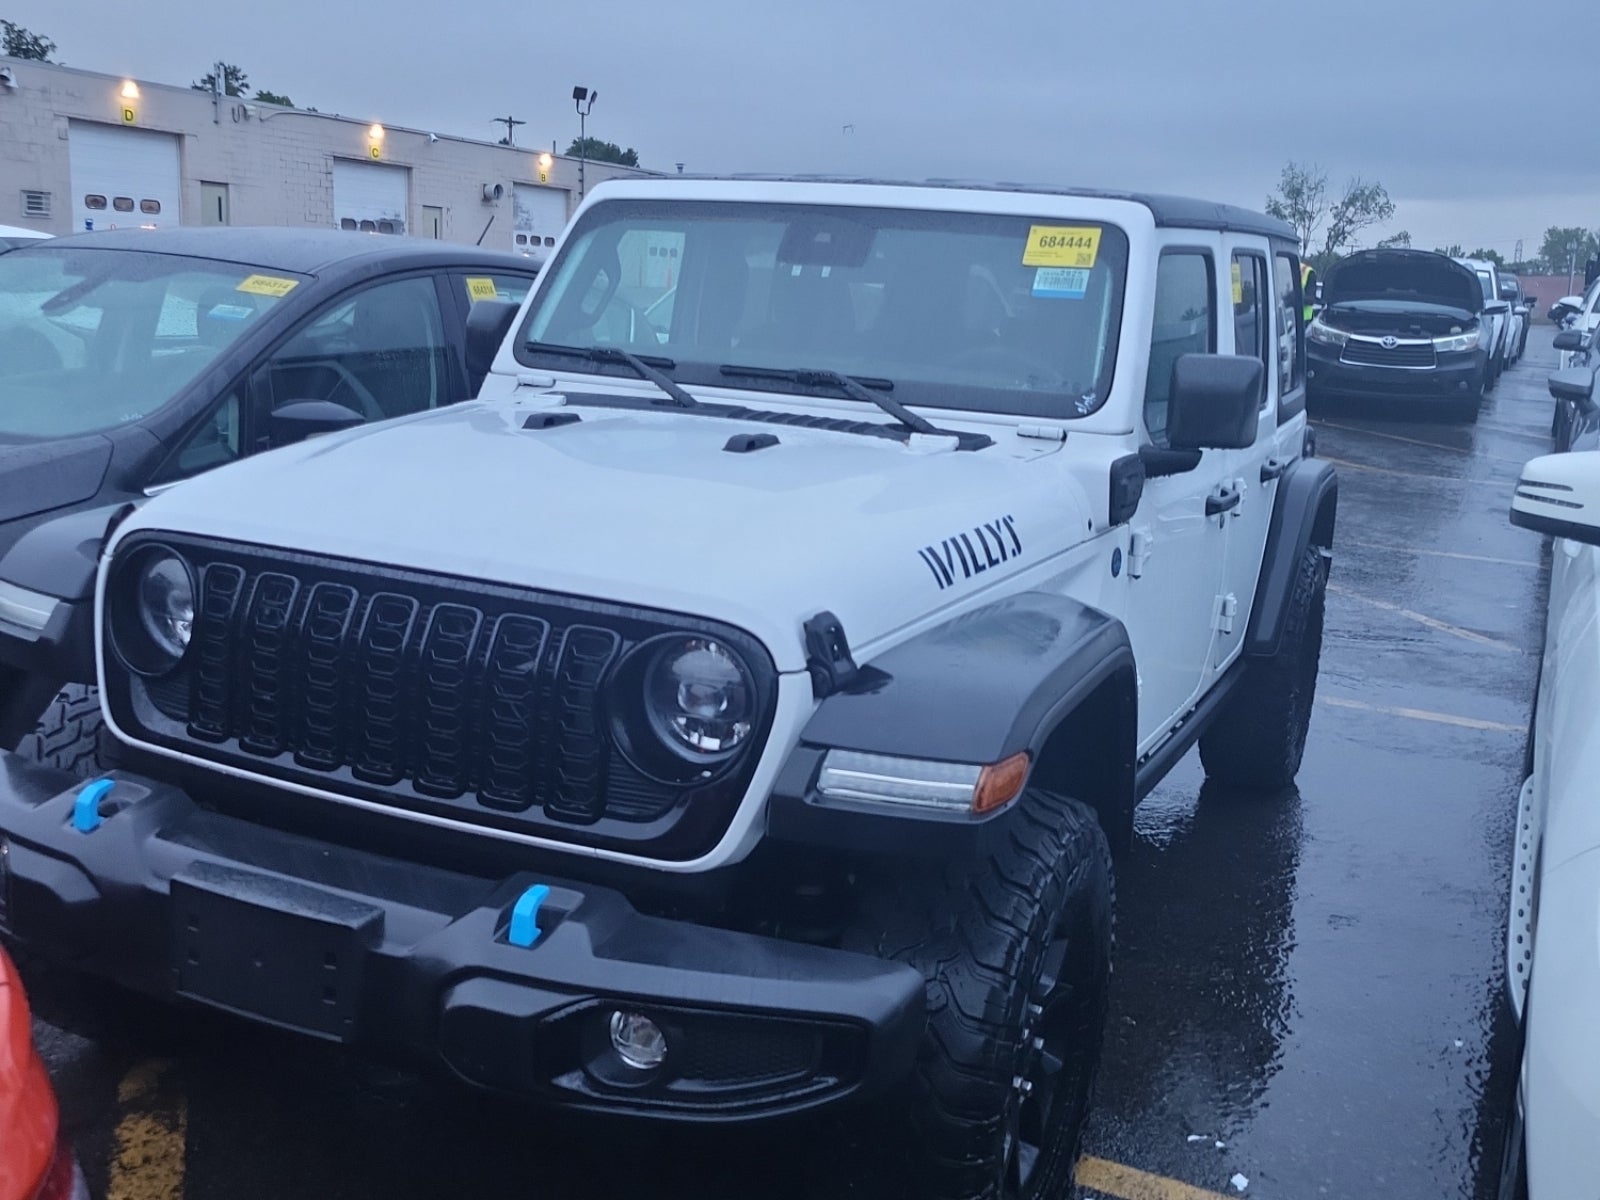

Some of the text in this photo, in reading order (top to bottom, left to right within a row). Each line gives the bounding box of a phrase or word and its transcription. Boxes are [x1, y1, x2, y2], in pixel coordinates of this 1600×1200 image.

[124, 109, 134, 121] D
[371, 147, 379, 158] C
[1038, 235, 1092, 249] 684444
[917, 514, 1022, 590] WILLYS
